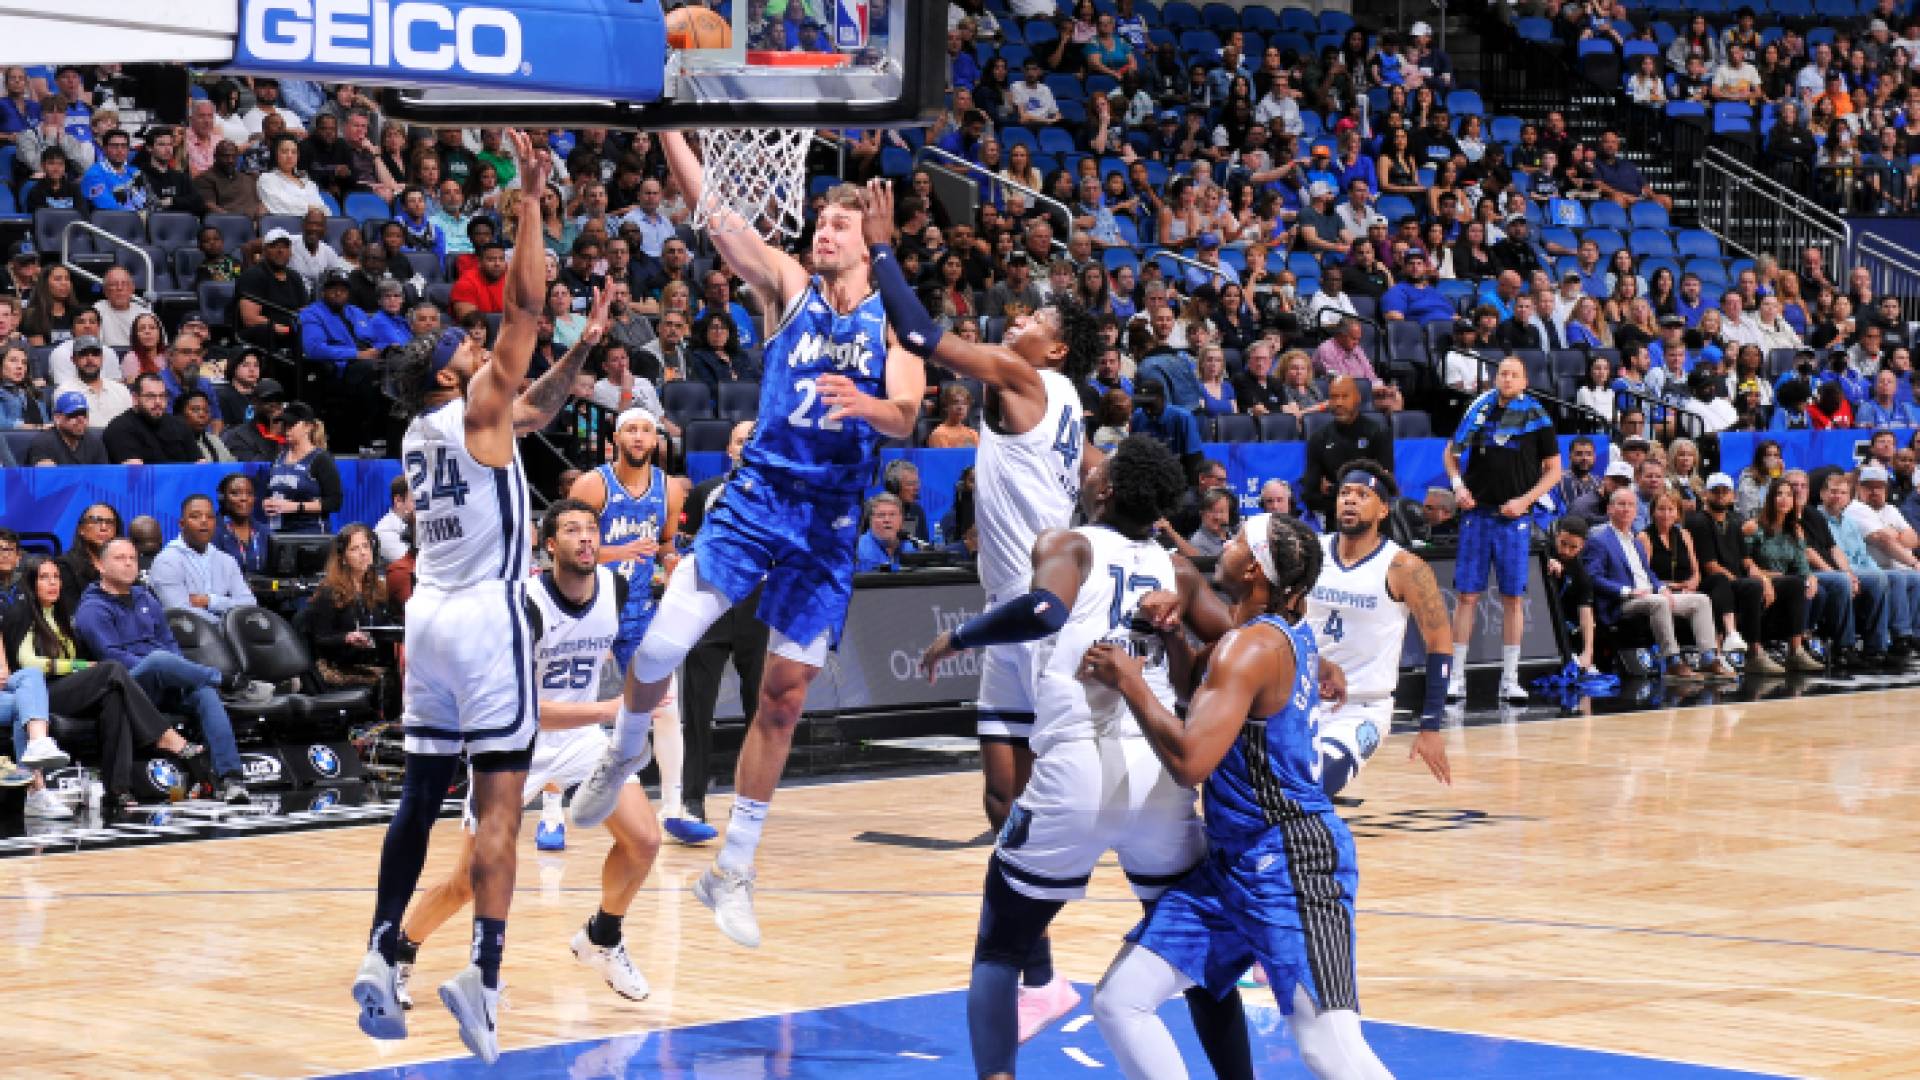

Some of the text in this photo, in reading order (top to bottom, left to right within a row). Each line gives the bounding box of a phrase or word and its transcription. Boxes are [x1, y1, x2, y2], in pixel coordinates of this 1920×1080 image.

[245, 0, 523, 74] GEICO
[788, 331, 873, 376] Magic
[405, 447, 469, 511] 24
[1323, 610, 1344, 643] 4
[542, 656, 595, 689] 25
